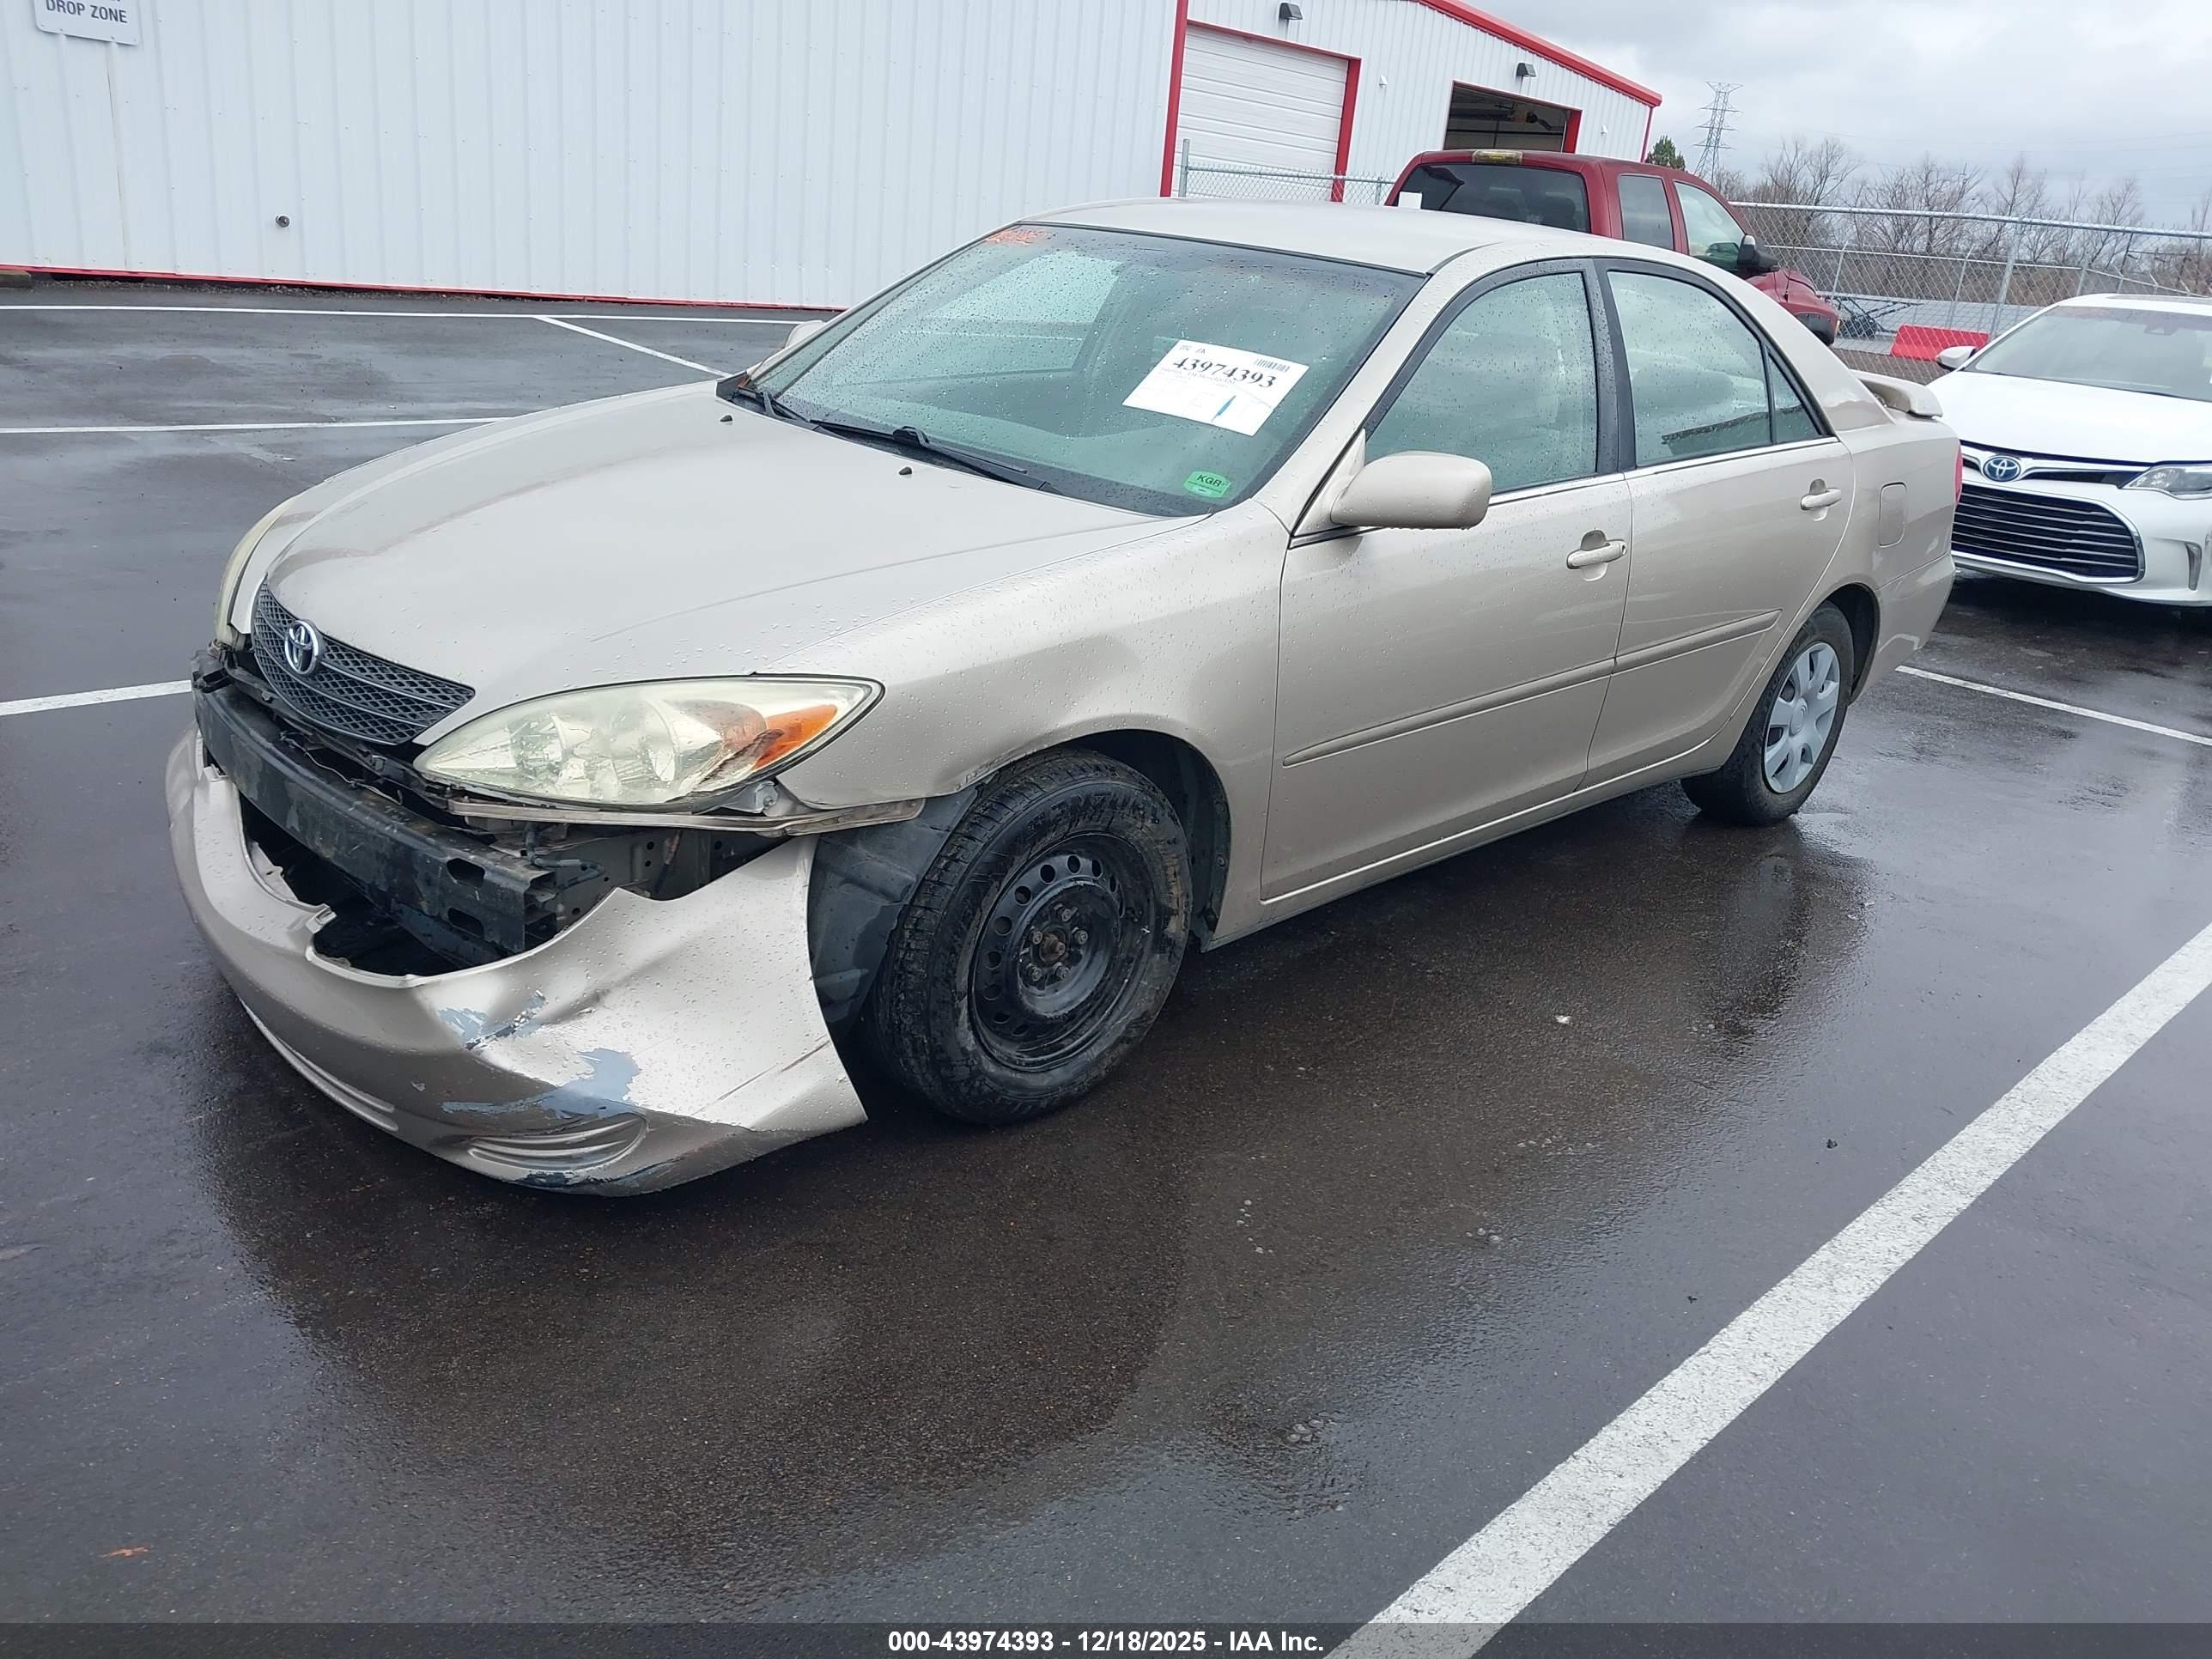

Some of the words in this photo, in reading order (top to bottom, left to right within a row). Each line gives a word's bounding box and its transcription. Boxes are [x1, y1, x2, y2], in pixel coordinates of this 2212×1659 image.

[46, 0, 86, 15] DROP
[89, 4, 128, 23] ZONE
[1172, 356, 1277, 388] 43974393
